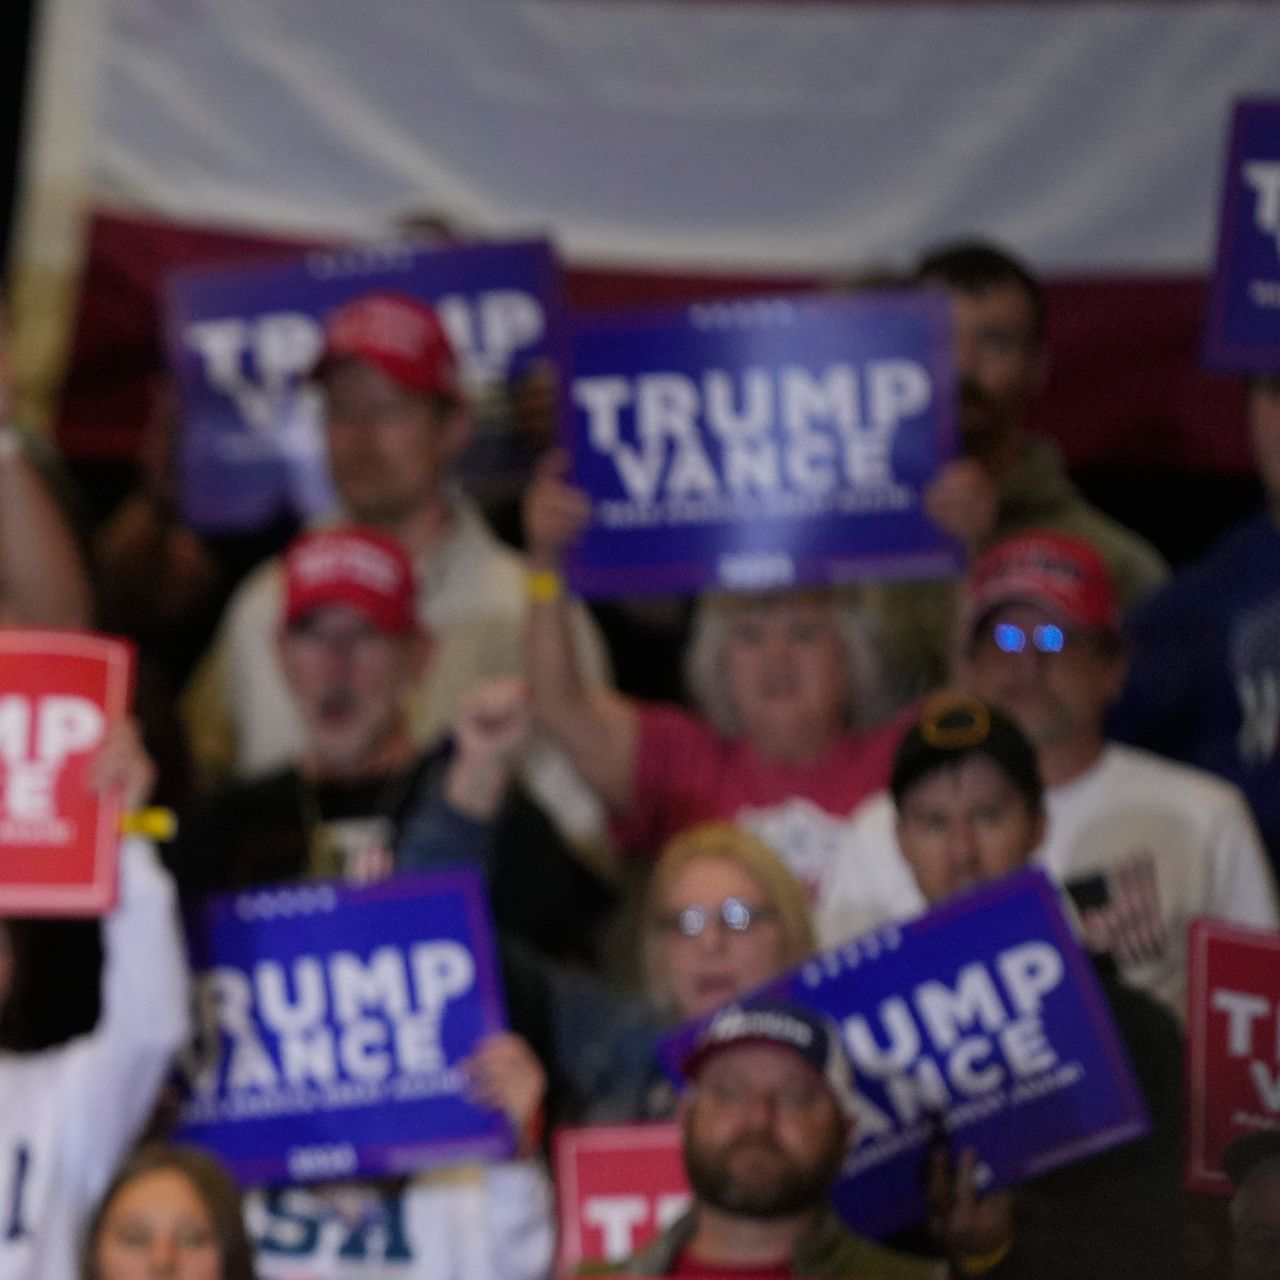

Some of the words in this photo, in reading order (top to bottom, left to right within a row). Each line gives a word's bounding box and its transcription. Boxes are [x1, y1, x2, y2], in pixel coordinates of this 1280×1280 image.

[186, 290, 543, 392] TRP
[571, 360, 932, 452] TRUMP
[615, 427, 895, 501] VANCE
[197, 938, 476, 1036] RUMP
[842, 940, 1066, 1082] UMP
